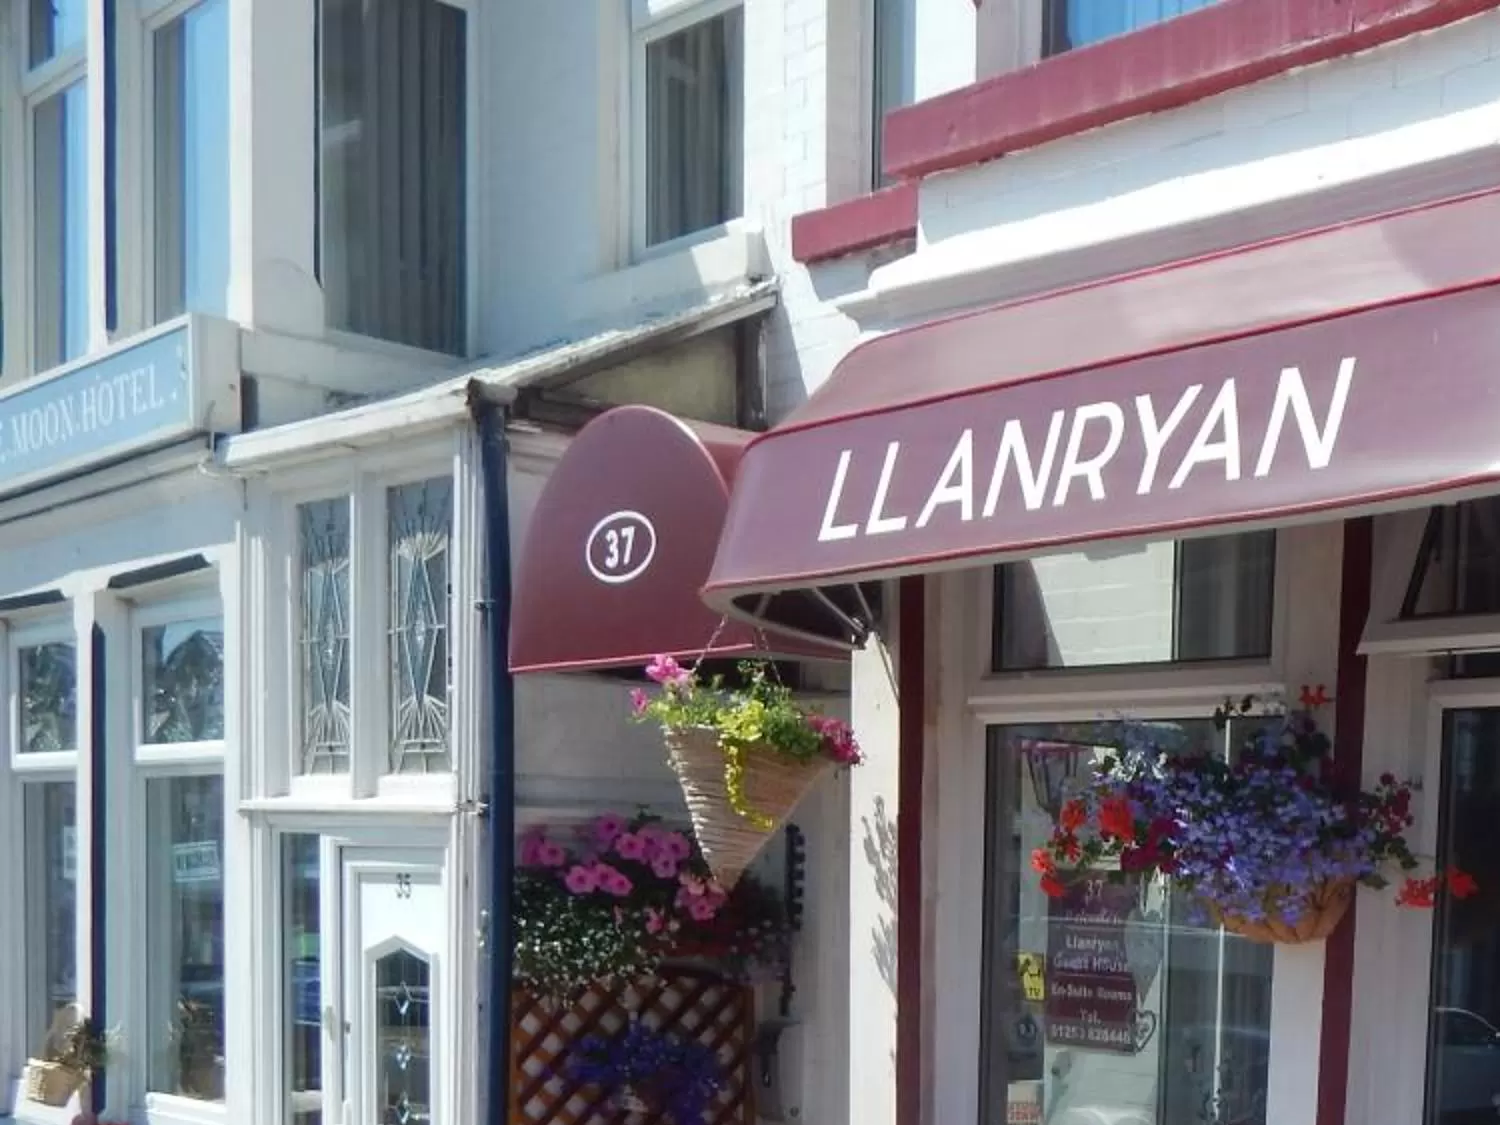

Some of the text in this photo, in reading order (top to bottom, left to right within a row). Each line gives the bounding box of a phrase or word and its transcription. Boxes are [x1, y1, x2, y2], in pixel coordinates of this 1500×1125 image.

[11, 394, 74, 456] MOON
[81, 362, 164, 433] HOTEL
[818, 357, 1357, 542] LLANRYAN
[605, 525, 636, 569] 37
[395, 872, 412, 899] 35
